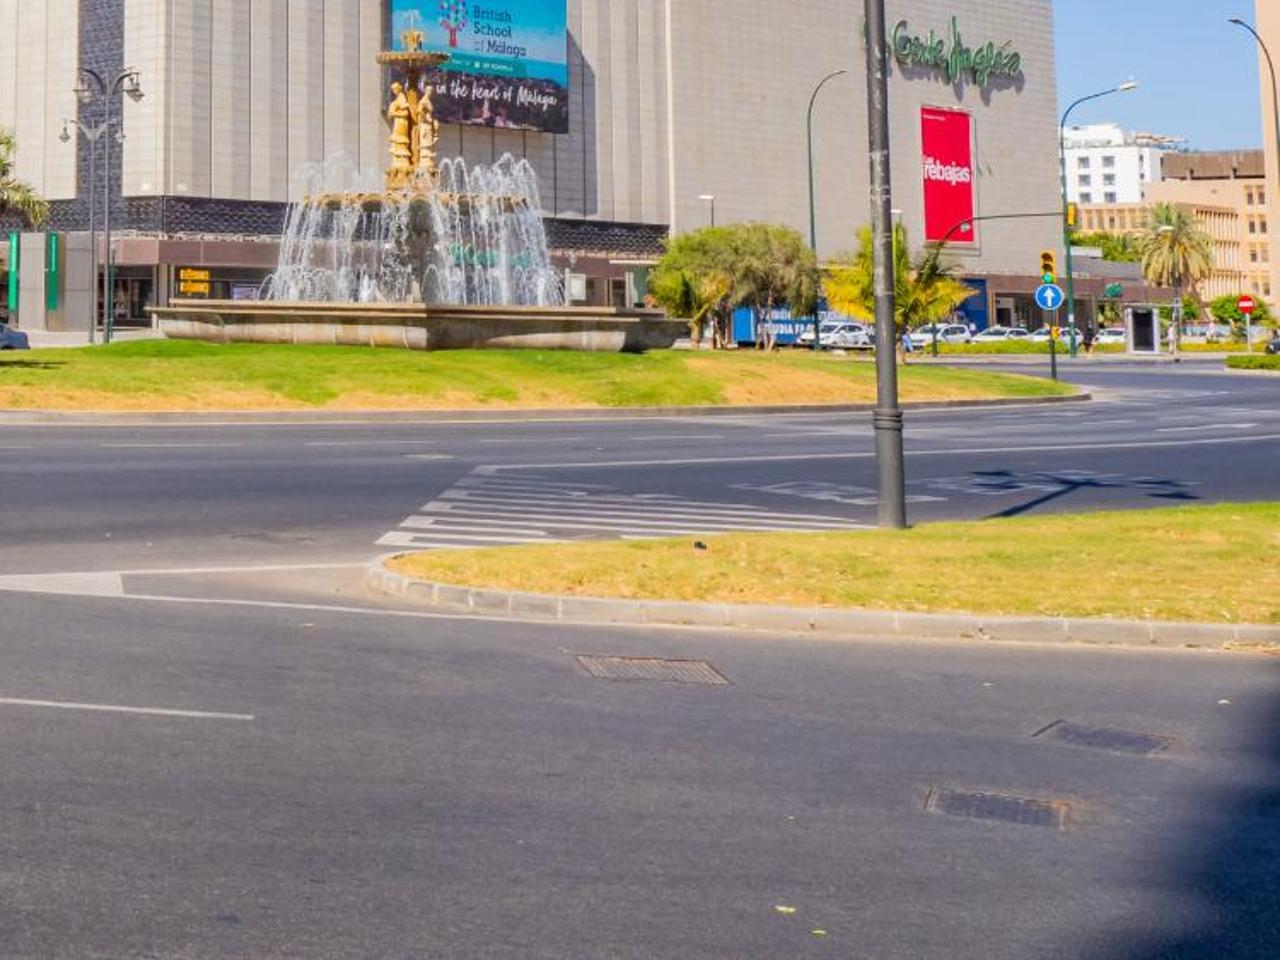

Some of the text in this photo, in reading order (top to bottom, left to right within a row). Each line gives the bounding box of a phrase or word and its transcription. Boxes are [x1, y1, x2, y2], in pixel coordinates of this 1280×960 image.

[473, 5, 512, 23] British
[473, 21, 512, 38] School
[893, 20, 944, 64] Corte
[436, 83, 446, 95] in
[450, 79, 468, 98] the
[503, 85, 513, 101] of
[924, 159, 970, 186] rebajas
